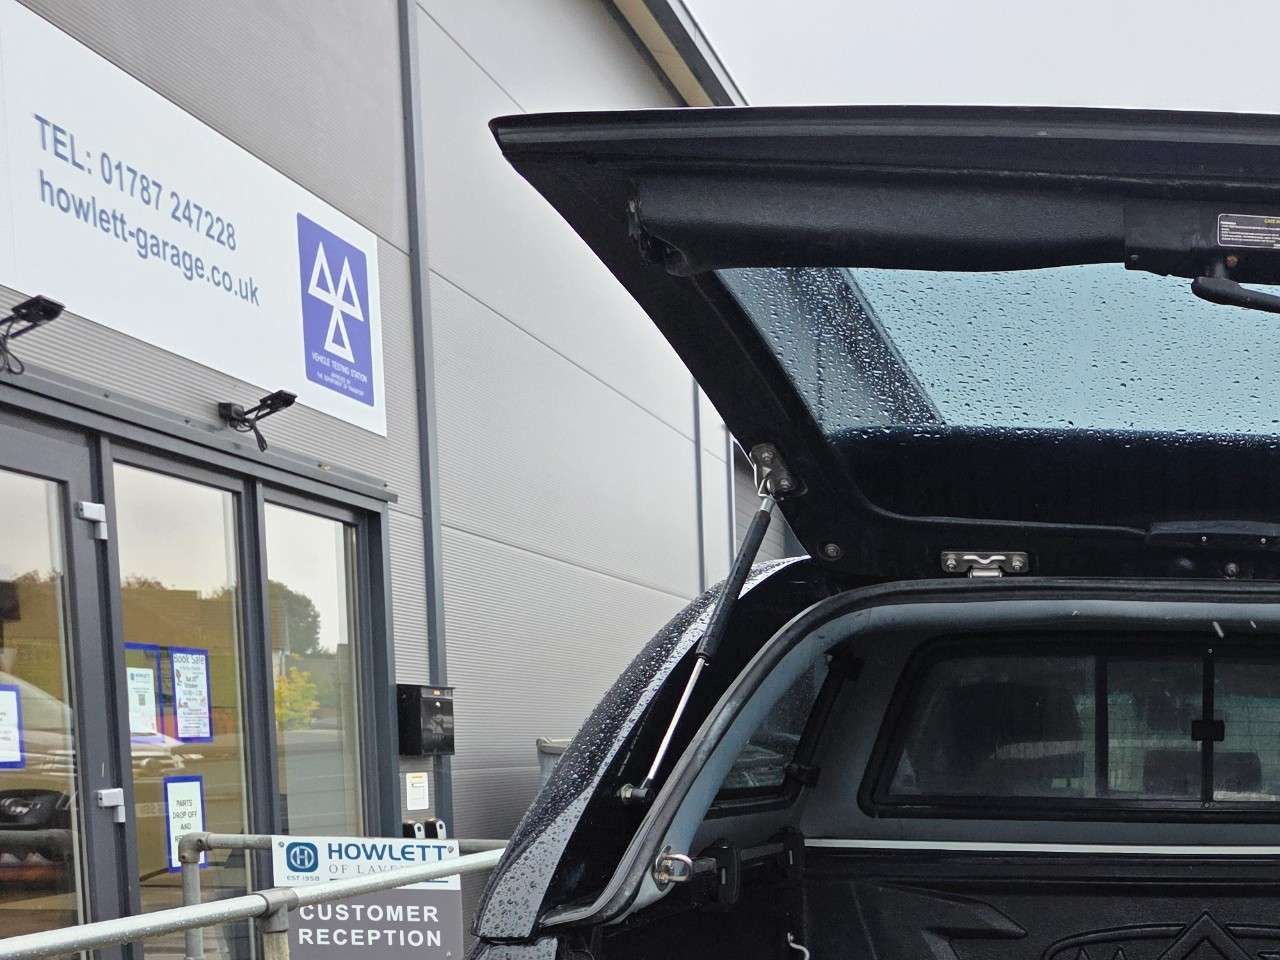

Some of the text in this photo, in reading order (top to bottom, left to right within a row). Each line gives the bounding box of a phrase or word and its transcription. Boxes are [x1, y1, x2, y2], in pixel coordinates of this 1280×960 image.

[34, 113, 237, 251] TEL: 01787 247228
[39, 170, 260, 306] howlett-garage.co.uk
[331, 360, 350, 375] TESTING
[351, 369, 367, 383] STATION
[176, 799, 192, 807] PARTS
[187, 810, 198, 818] OFF
[328, 843, 447, 862] HOWLETT
[328, 864, 348, 874] OF
[299, 904, 439, 922] CUSTOMER
[298, 928, 441, 947] RECEPTION
